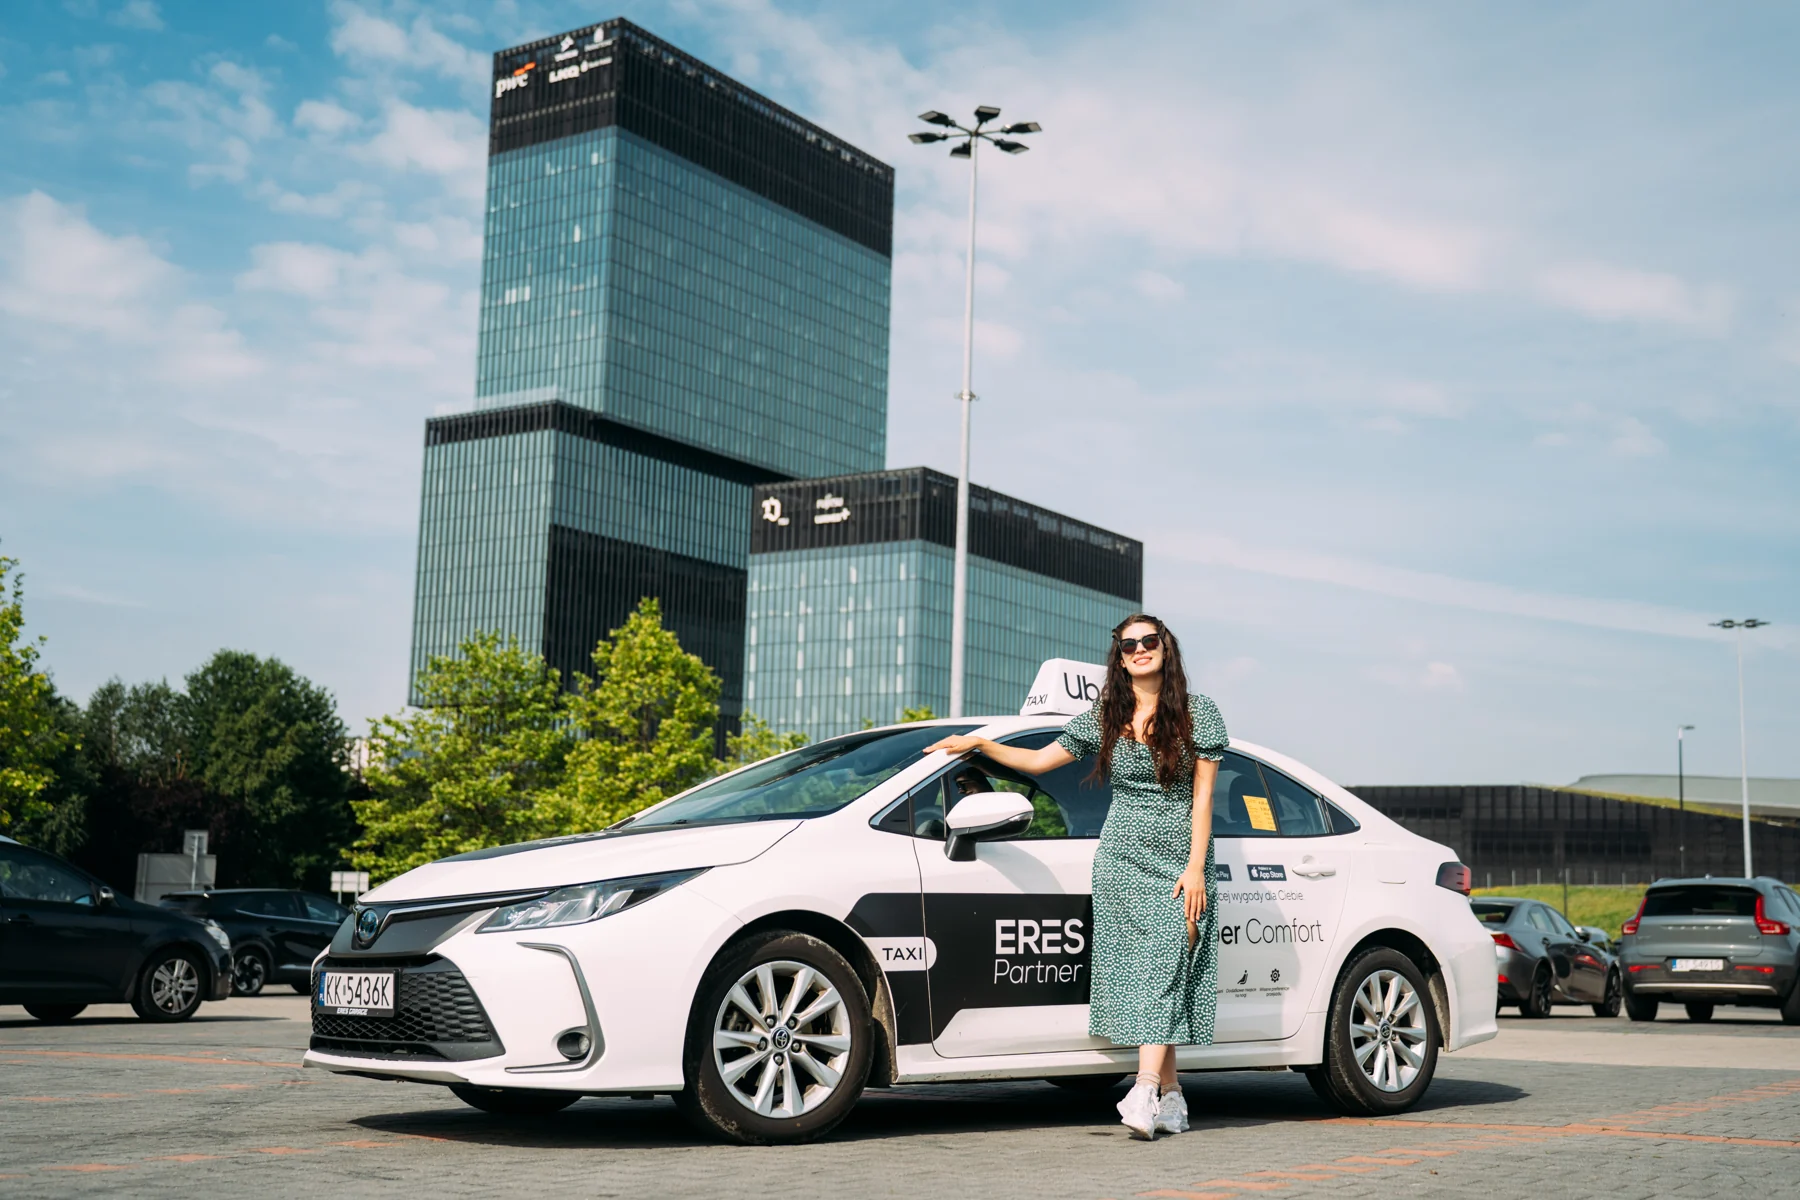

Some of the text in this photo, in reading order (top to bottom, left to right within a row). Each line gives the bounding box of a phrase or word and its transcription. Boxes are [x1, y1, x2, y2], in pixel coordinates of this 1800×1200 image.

[1026, 694, 1048, 707] TAXI
[1064, 672, 1100, 702] Ub
[1260, 871, 1270, 879] App
[1218, 890, 1304, 903] cej wygody dla Ciebie
[995, 918, 1085, 955] ERES
[1217, 917, 1324, 945] er Comfort
[882, 947, 923, 961] TAXI
[993, 958, 1084, 985] Partner
[326, 976, 341, 1004] KK
[347, 976, 390, 1006] 5436K
